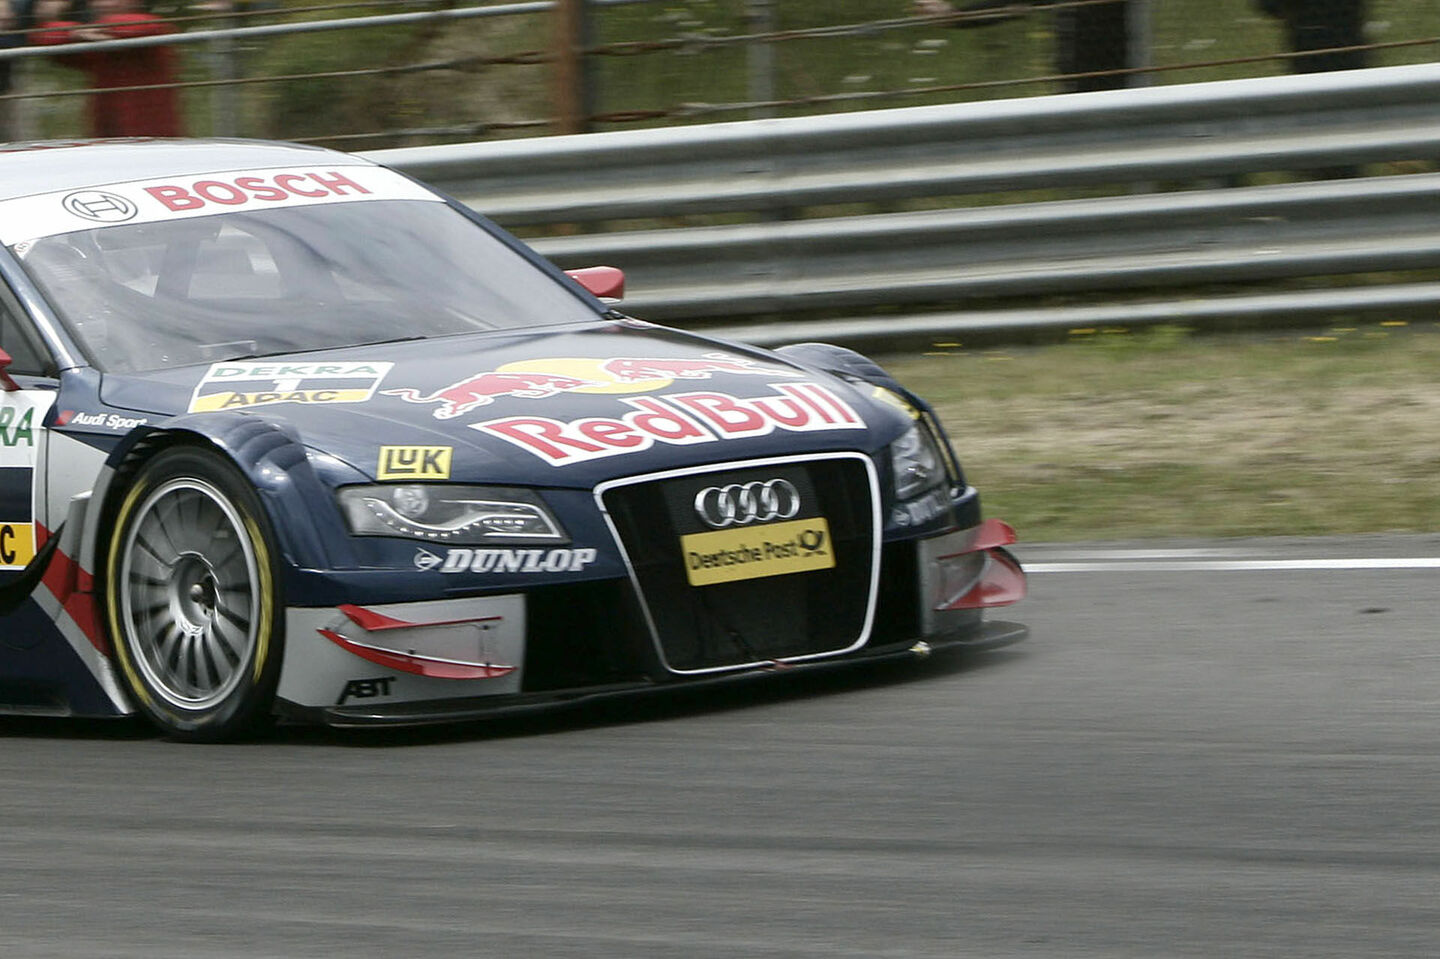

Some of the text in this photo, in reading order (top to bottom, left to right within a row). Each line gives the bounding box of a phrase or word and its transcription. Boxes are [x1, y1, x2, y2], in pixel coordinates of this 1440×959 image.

[143, 171, 374, 212] BOSCH
[211, 365, 379, 378] DEKRA
[273, 378, 301, 391] 1
[220, 390, 339, 409] ADAC
[72, 412, 147, 429] Audi Sport
[477, 397, 711, 462] Red
[669, 383, 859, 436] Bull
[440, 547, 597, 574] DUNLOP
[688, 540, 799, 570] Deutsche Post
[336, 676, 397, 705] ABT
